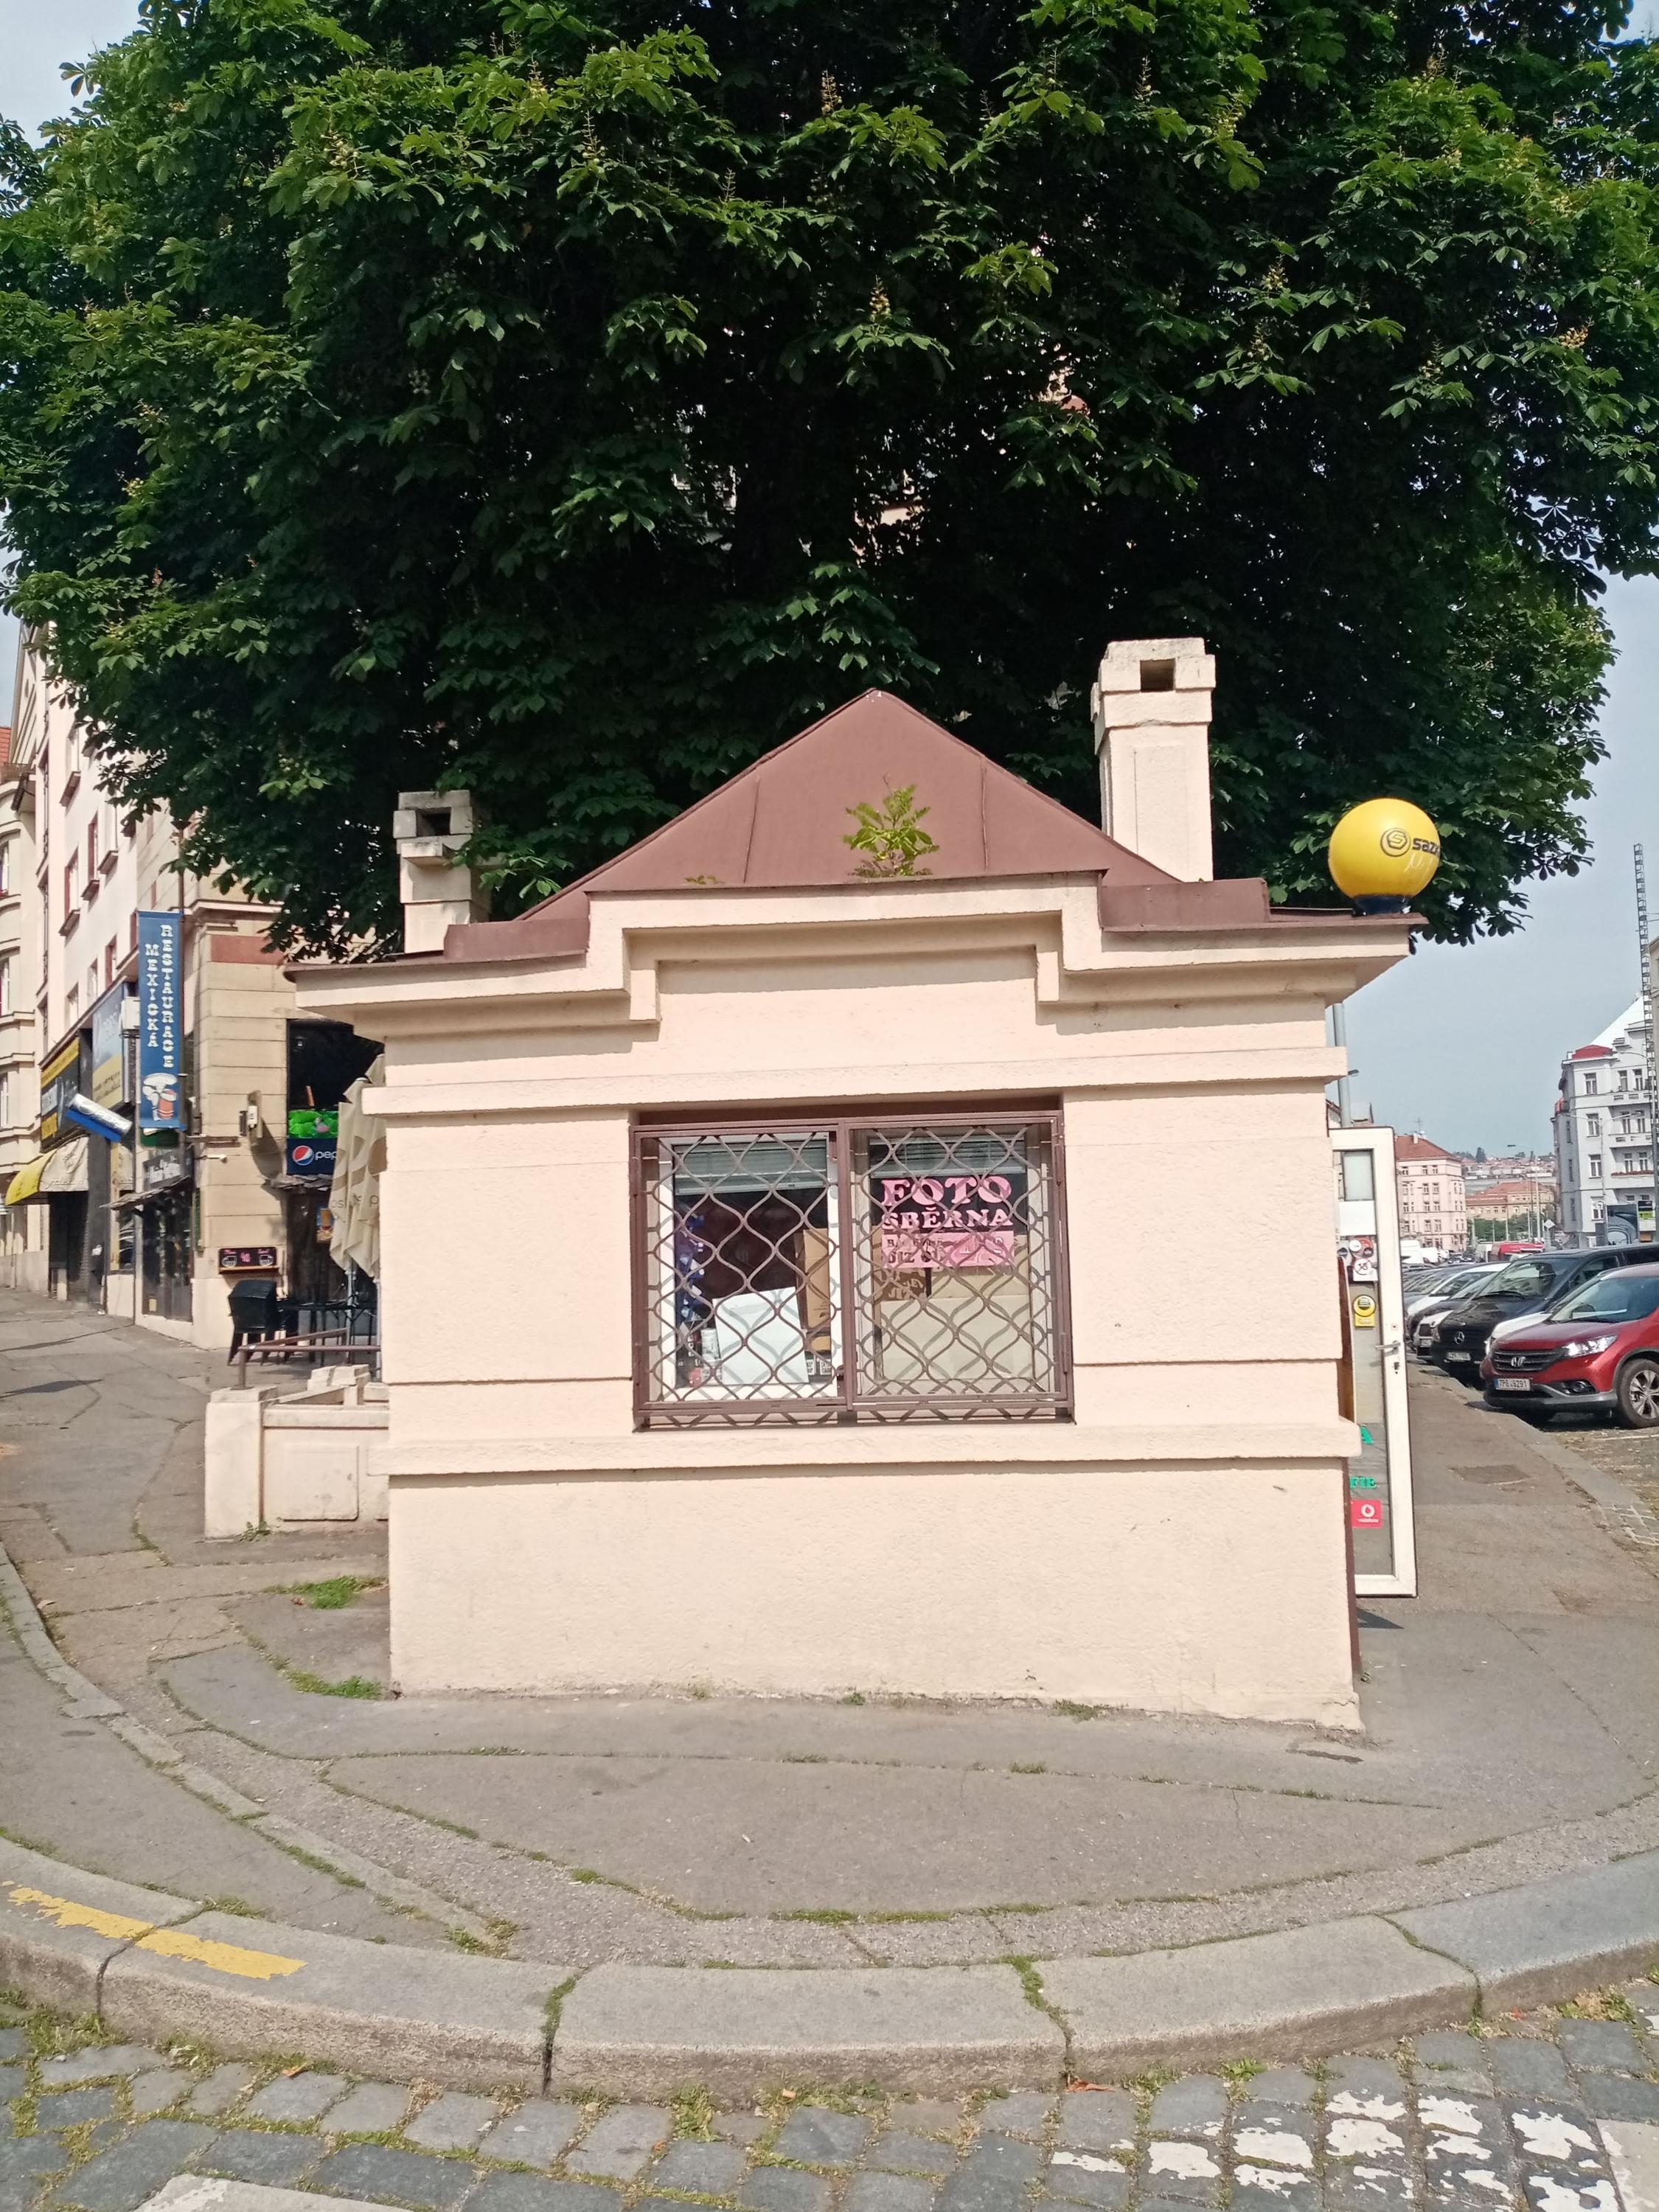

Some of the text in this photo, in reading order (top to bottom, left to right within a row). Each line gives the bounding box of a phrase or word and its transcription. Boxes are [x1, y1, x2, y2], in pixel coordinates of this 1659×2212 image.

[145, 944, 159, 1047] MEXICKÁ
[160, 925, 174, 1068] RESTAURACE
[314, 1151, 337, 1161] pep
[881, 1176, 1012, 1206] FOTO
[882, 1206, 1013, 1229] SBĚRNA
